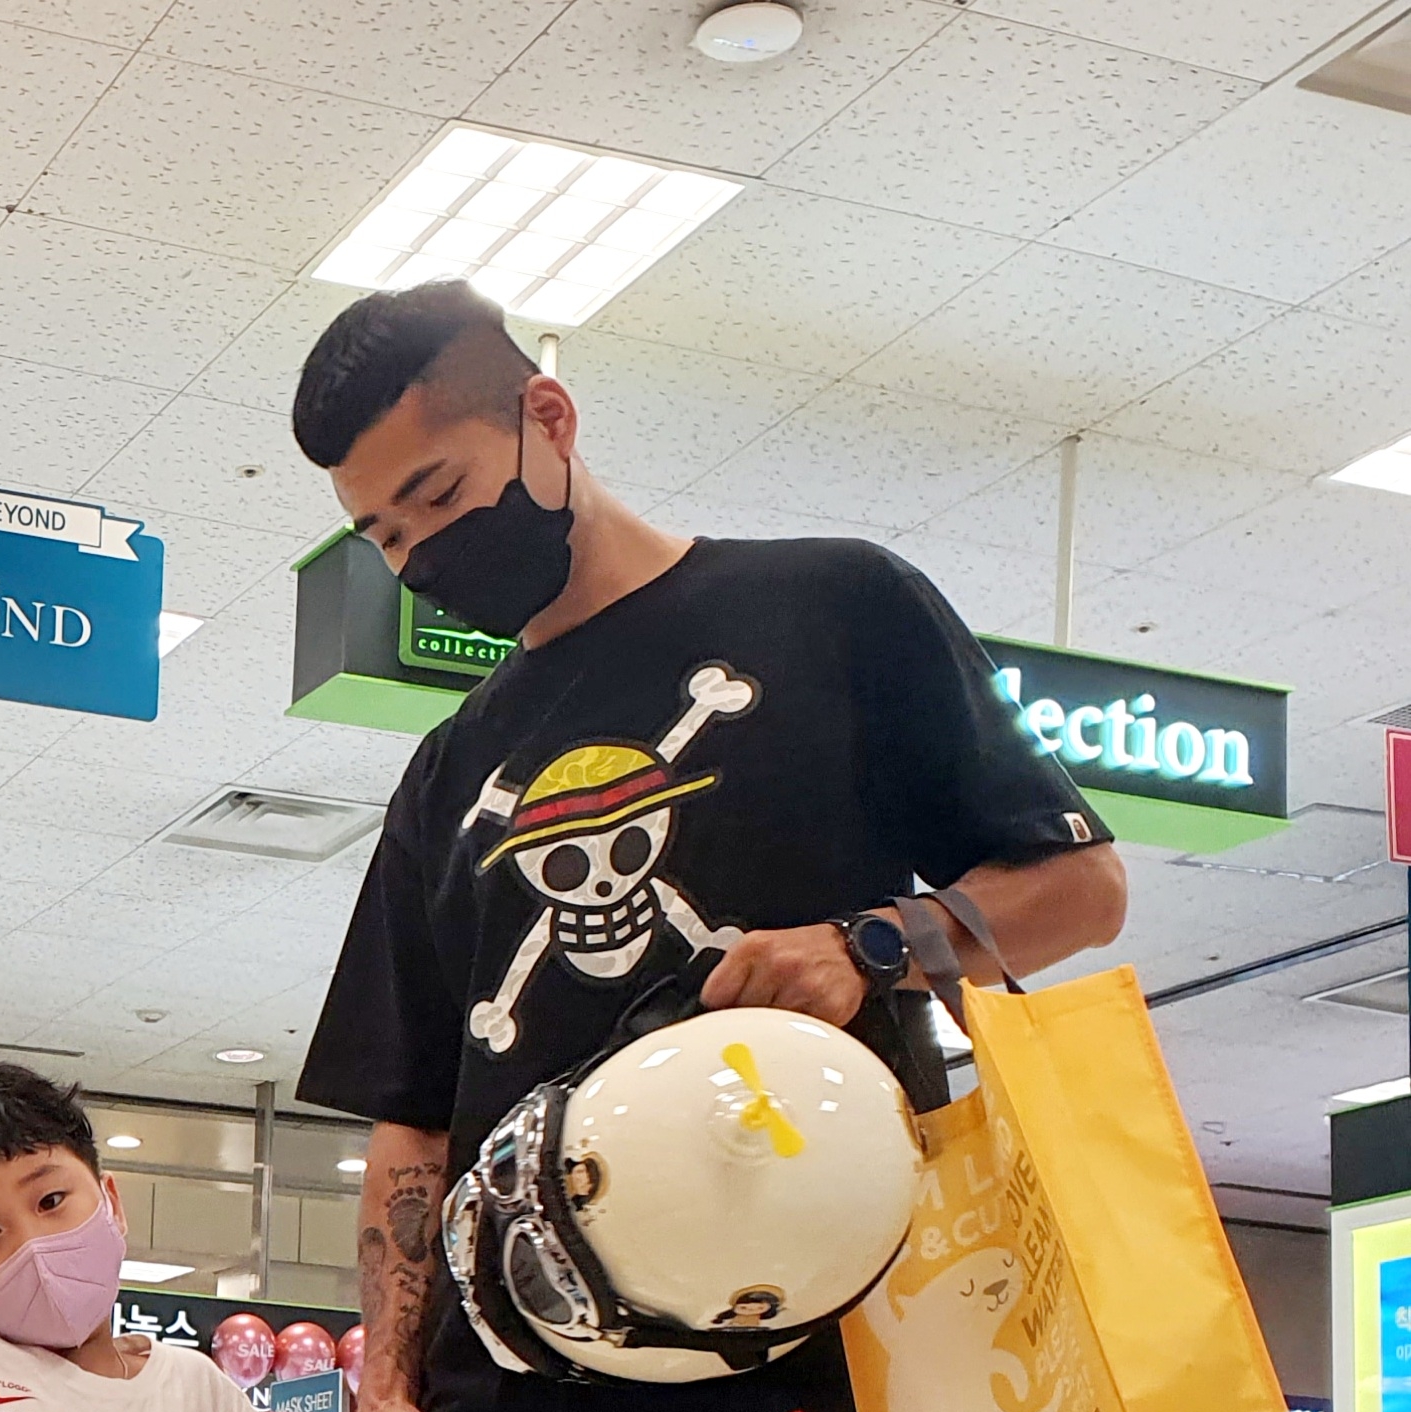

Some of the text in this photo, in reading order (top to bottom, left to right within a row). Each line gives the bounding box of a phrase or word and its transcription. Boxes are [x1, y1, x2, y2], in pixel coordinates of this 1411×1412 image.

[237, 1343, 275, 1358] SALE
[303, 1357, 336, 1372] SALE
[303, 1390, 334, 1412] SHEET
